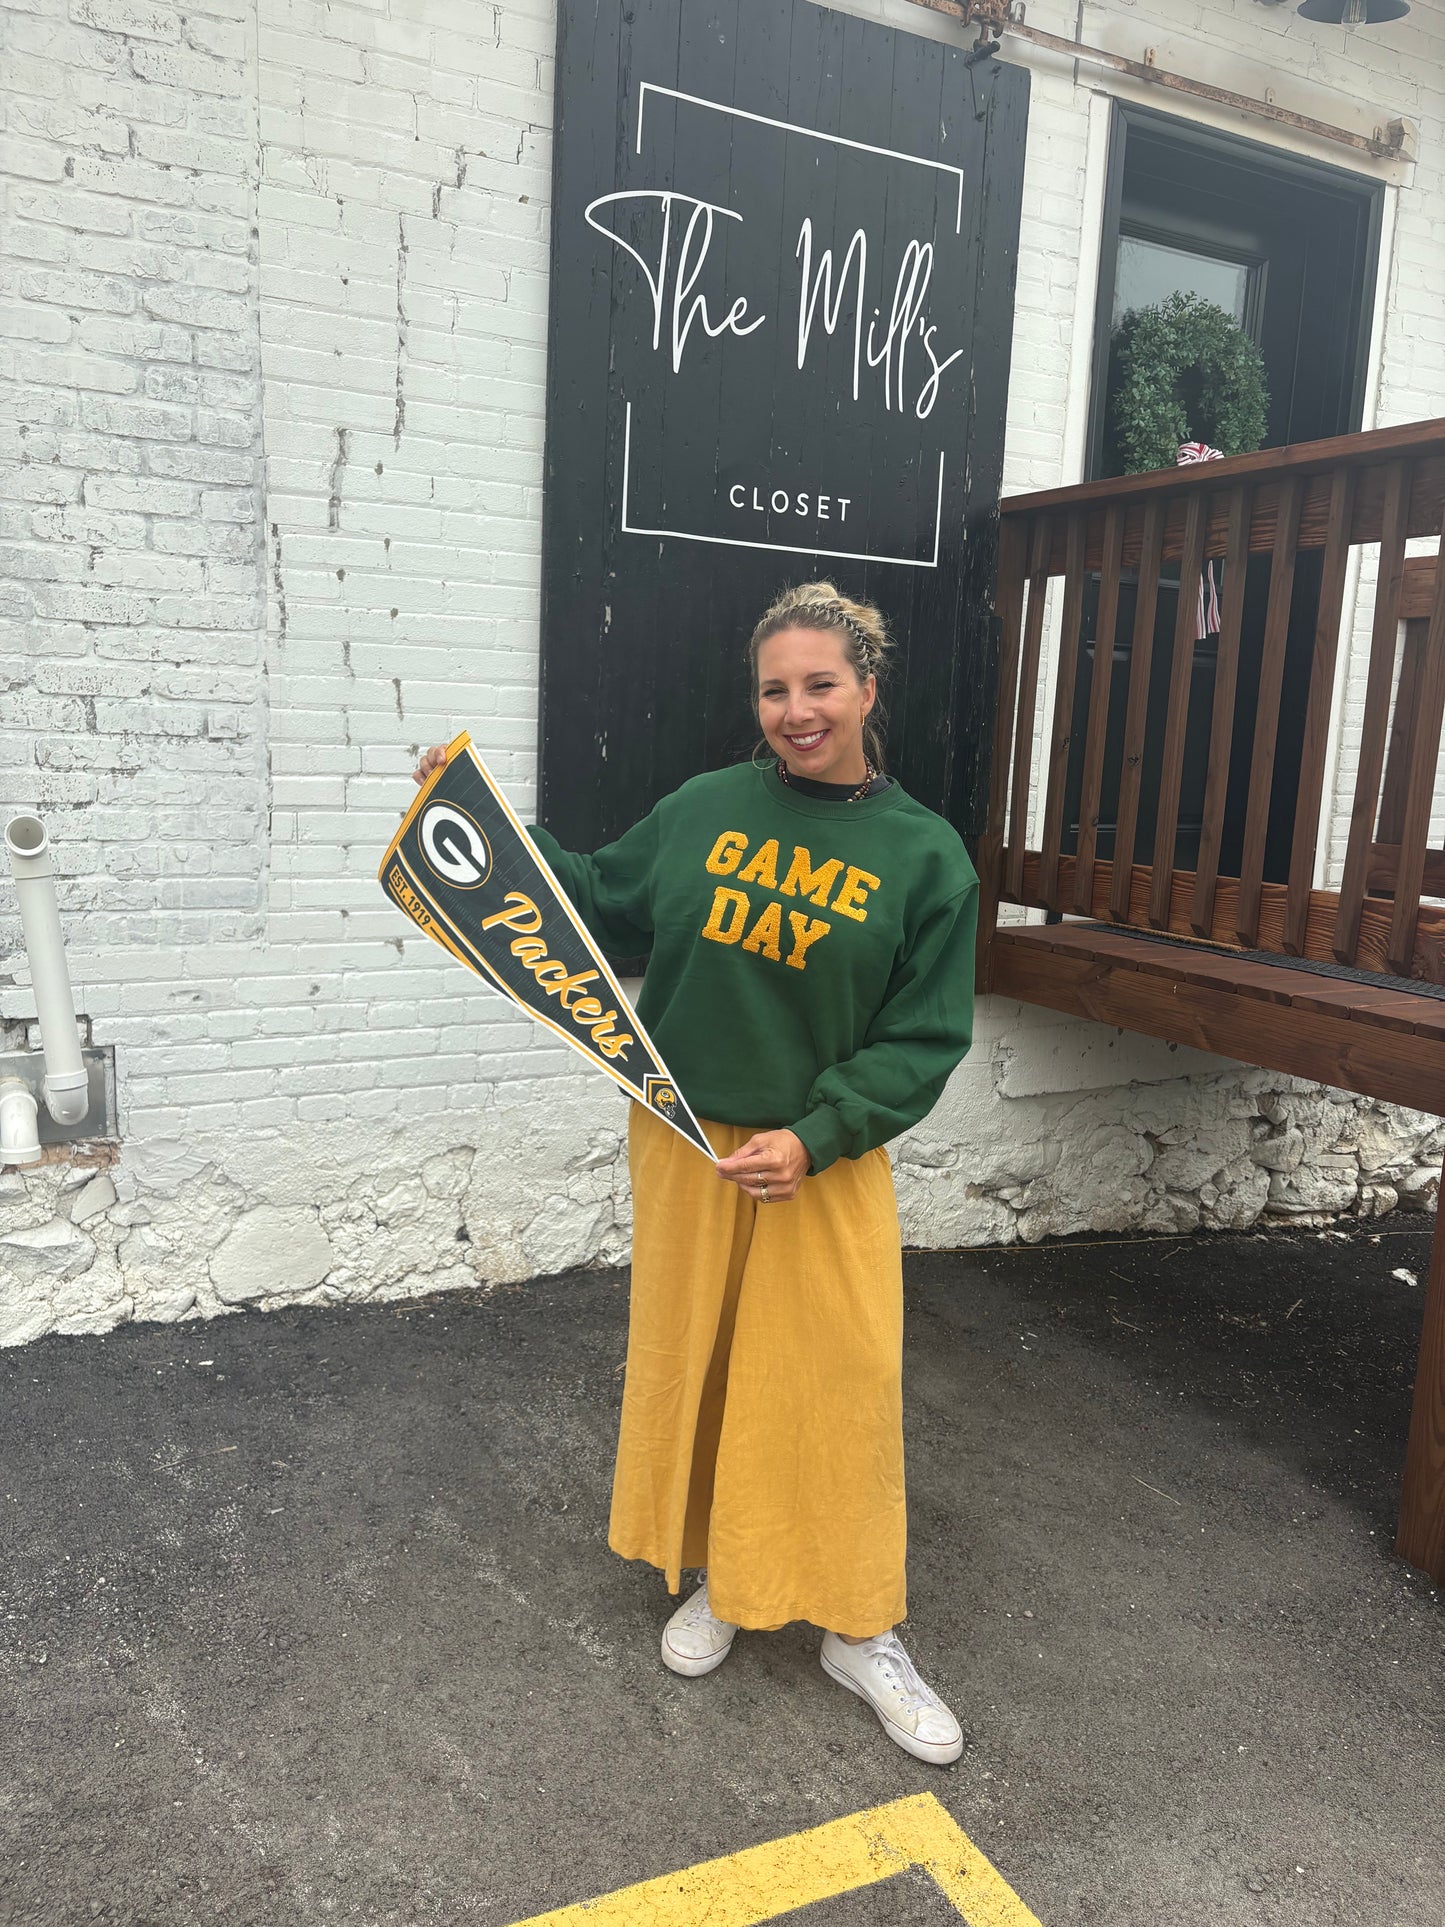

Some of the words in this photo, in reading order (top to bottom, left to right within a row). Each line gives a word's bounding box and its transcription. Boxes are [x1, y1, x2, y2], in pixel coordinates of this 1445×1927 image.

[584, 190, 766, 374] The
[796, 217, 964, 419] Mill's
[729, 484, 852, 522] CLOSET
[422, 805, 486, 883] G
[705, 831, 881, 923] GAME
[391, 868, 407, 899] EST.
[408, 895, 432, 926] 1919
[702, 886, 831, 970] DAY
[481, 891, 634, 1062] Packers
